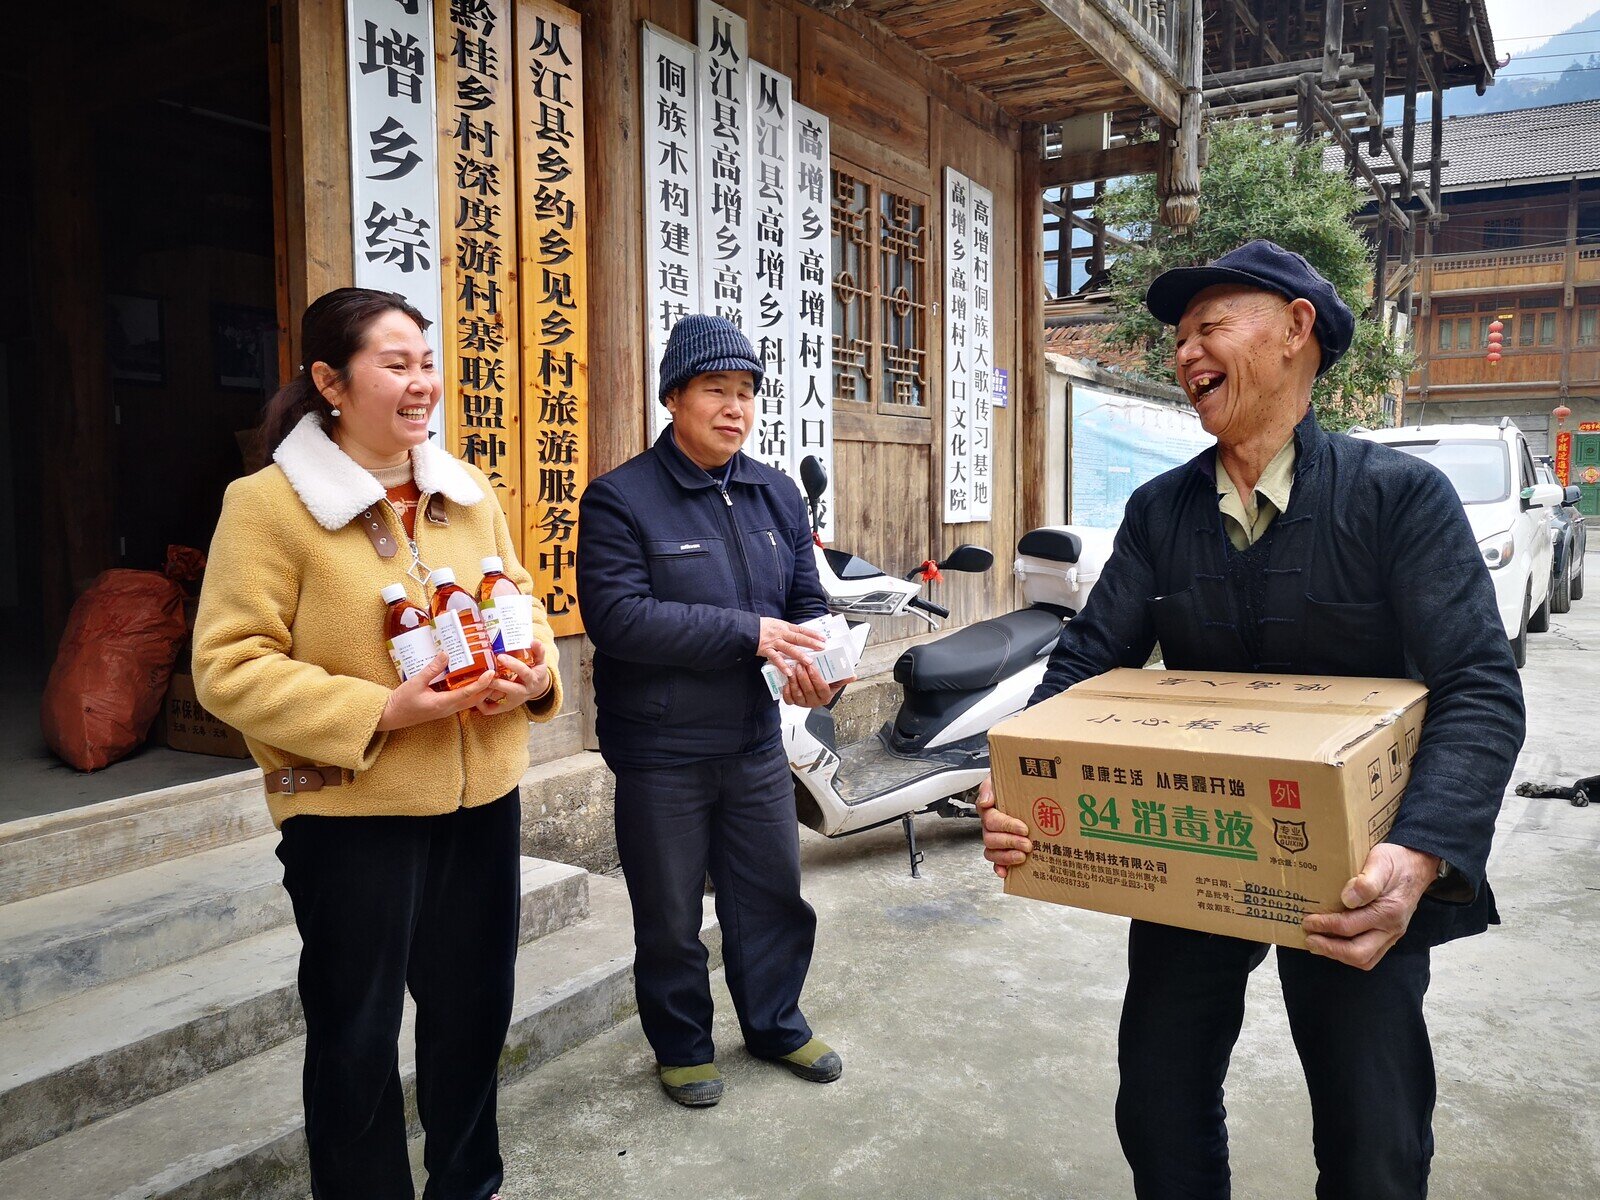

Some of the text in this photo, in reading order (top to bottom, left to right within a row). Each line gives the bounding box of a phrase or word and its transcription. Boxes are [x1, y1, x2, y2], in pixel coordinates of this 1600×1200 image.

[529, 16, 579, 617] 从江县乡约乡见乡村旅游服务中心
[951, 180, 967, 512] 高增乡高增村人口文化大院
[973, 198, 989, 505] 高增村侗族大歌传习基地
[1082, 764, 1246, 797] 健康生活 从贵鑫开始
[1274, 783, 1298, 806] 外
[1037, 801, 1062, 832] 新
[1077, 793, 1257, 849] 84 消毒液
[1281, 825, 1301, 837] 专业
[1032, 840, 1168, 874] 贵州鑫源生物科技有限公司
[1246, 906, 1304, 925] 2021020
